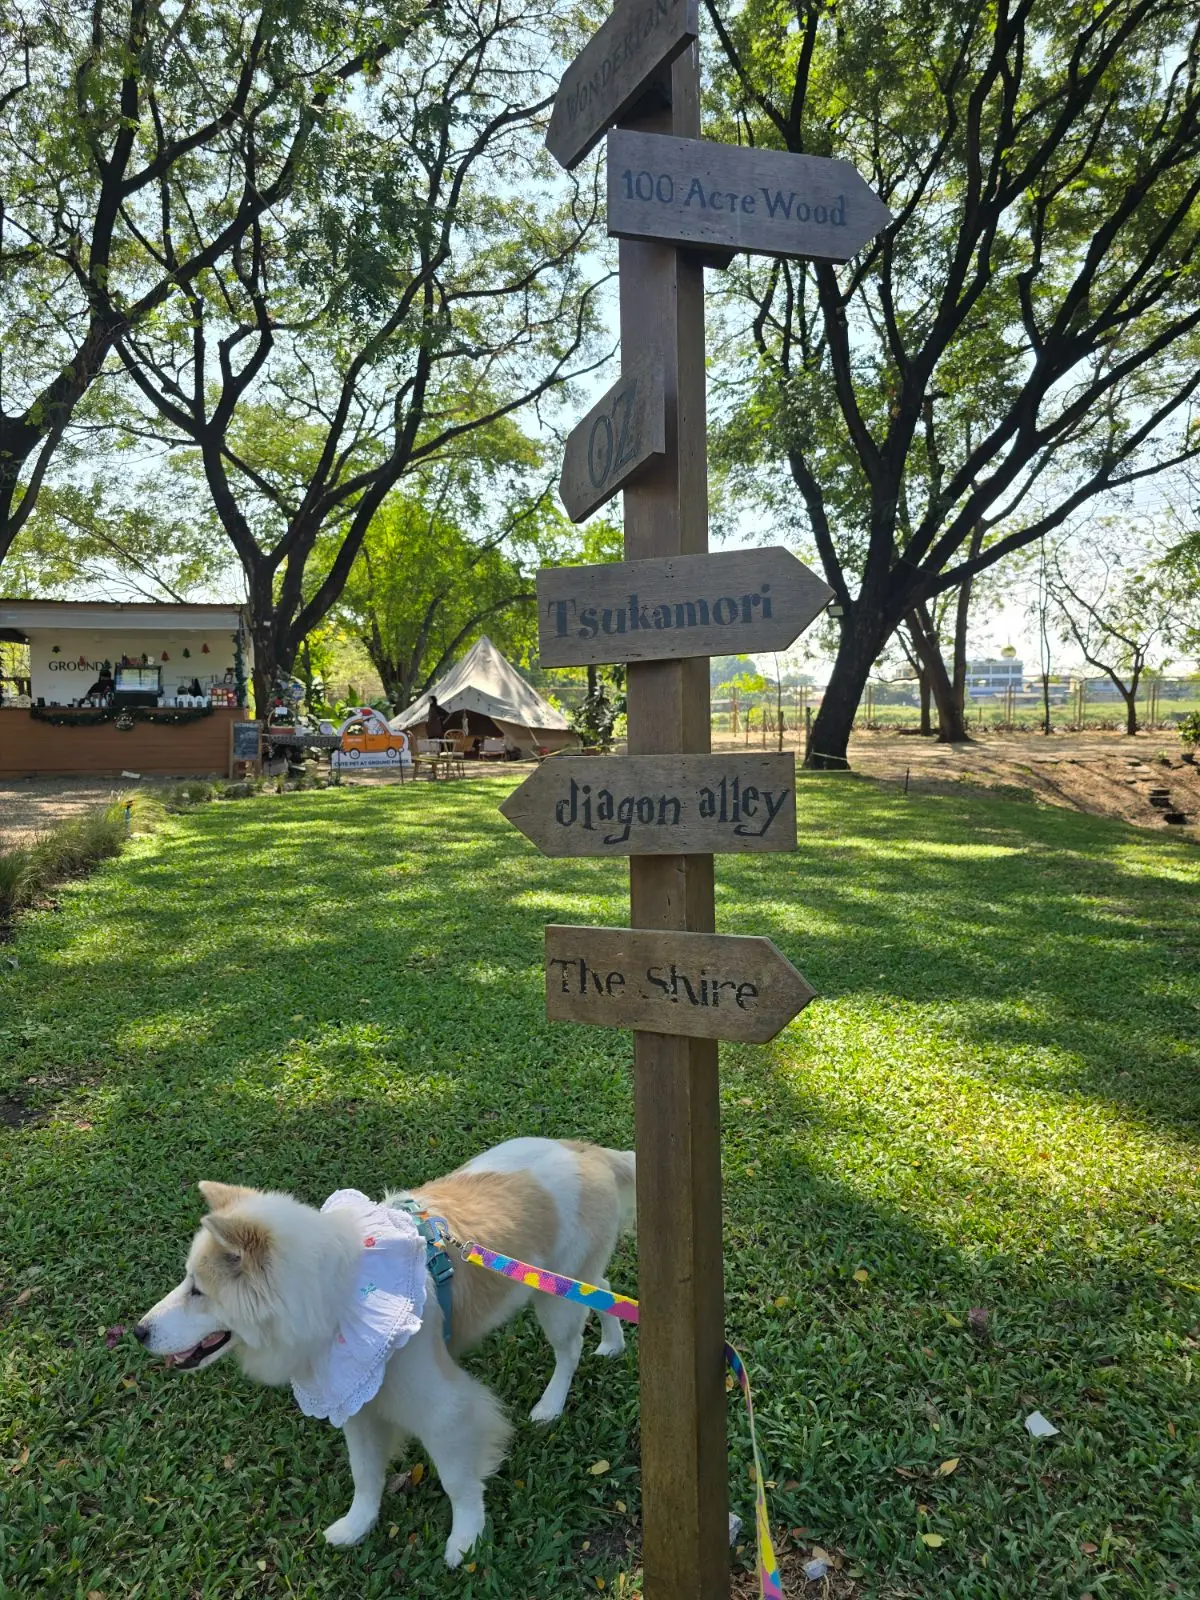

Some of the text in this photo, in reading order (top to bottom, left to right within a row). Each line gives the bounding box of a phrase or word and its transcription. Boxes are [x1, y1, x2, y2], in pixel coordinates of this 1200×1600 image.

[566, 0, 670, 121] WONDERLAN
[621, 168, 675, 204] 100
[587, 378, 641, 489] OZ
[547, 583, 773, 638] Tsukamori
[48, 660, 105, 672] GROUND
[555, 775, 790, 844] diagon alley
[550, 958, 760, 1011] The Shire
